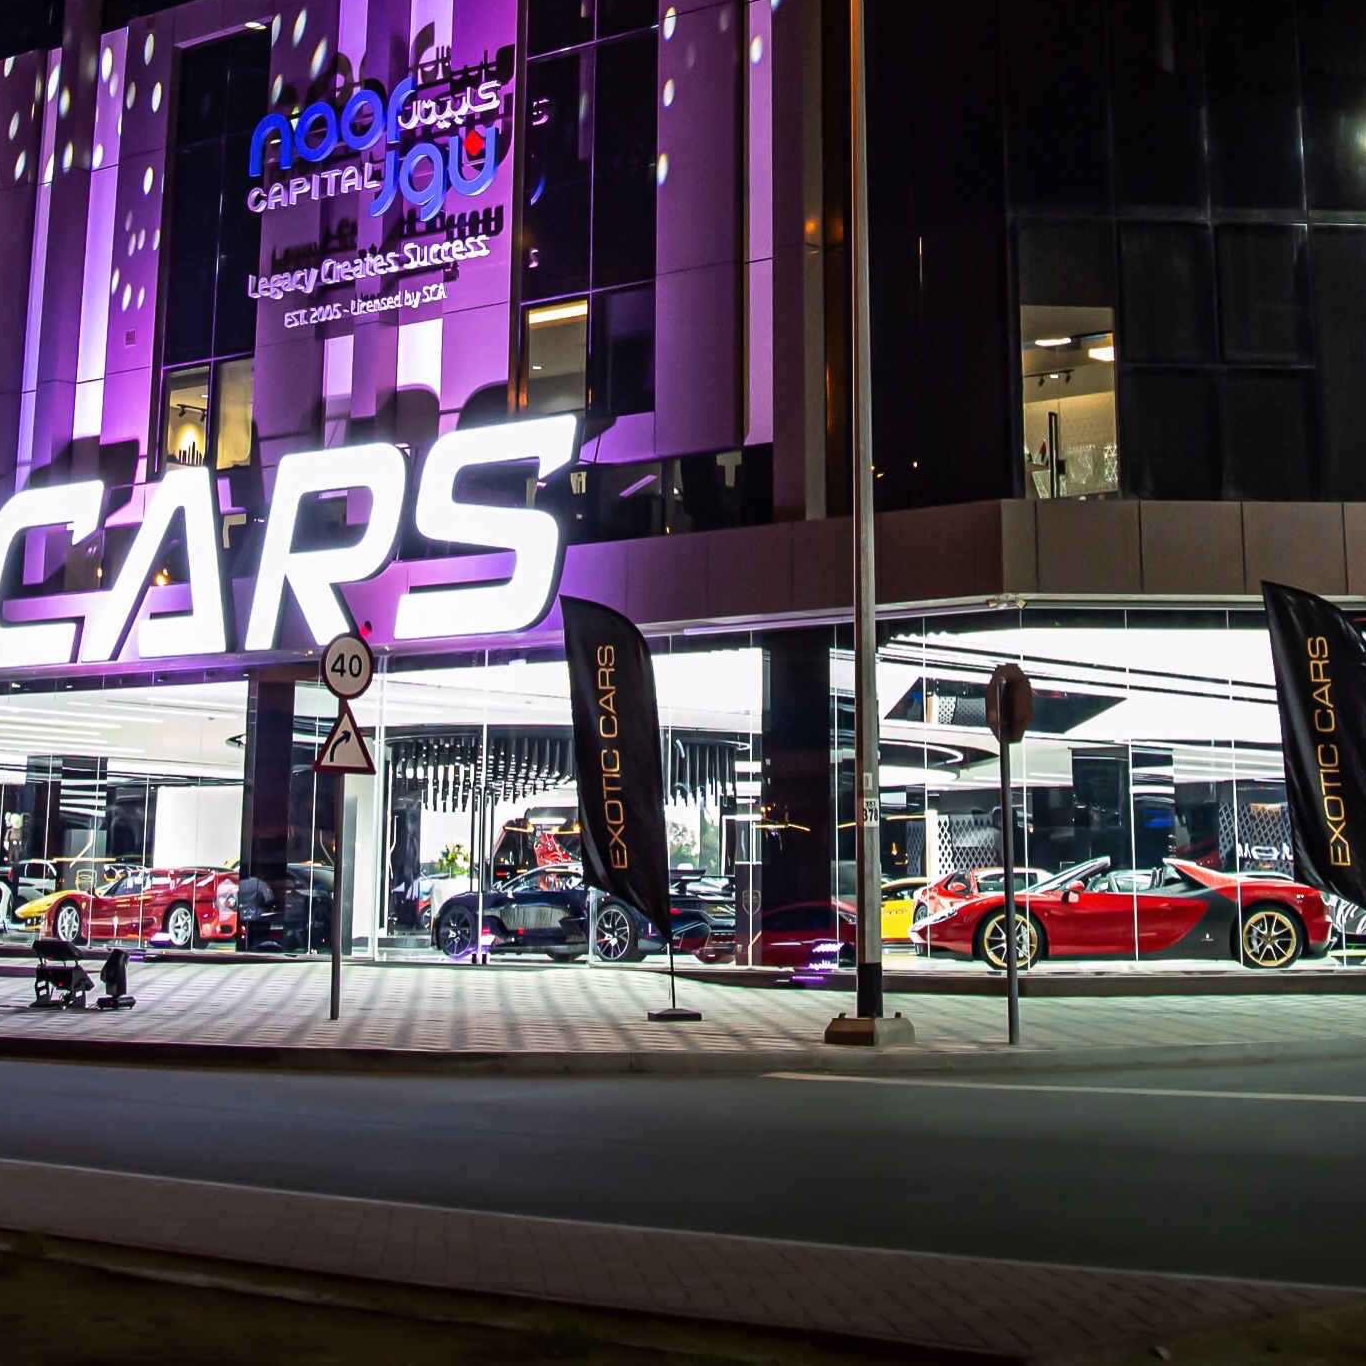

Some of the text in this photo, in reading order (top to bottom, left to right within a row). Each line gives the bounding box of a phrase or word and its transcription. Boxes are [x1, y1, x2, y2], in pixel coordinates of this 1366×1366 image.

[249, 76, 415, 177] noor
[247, 162, 381, 213] CAPITAL
[248, 235, 490, 299] Legacy Creates Success
[350, 293, 402, 316] Licensed
[404, 289, 421, 309] by
[422, 283, 448, 303] SCA
[331, 653, 362, 678] 40
[597, 645, 629, 869] EXOTIC CARS
[1307, 636, 1351, 866] EXOTIC CARS
